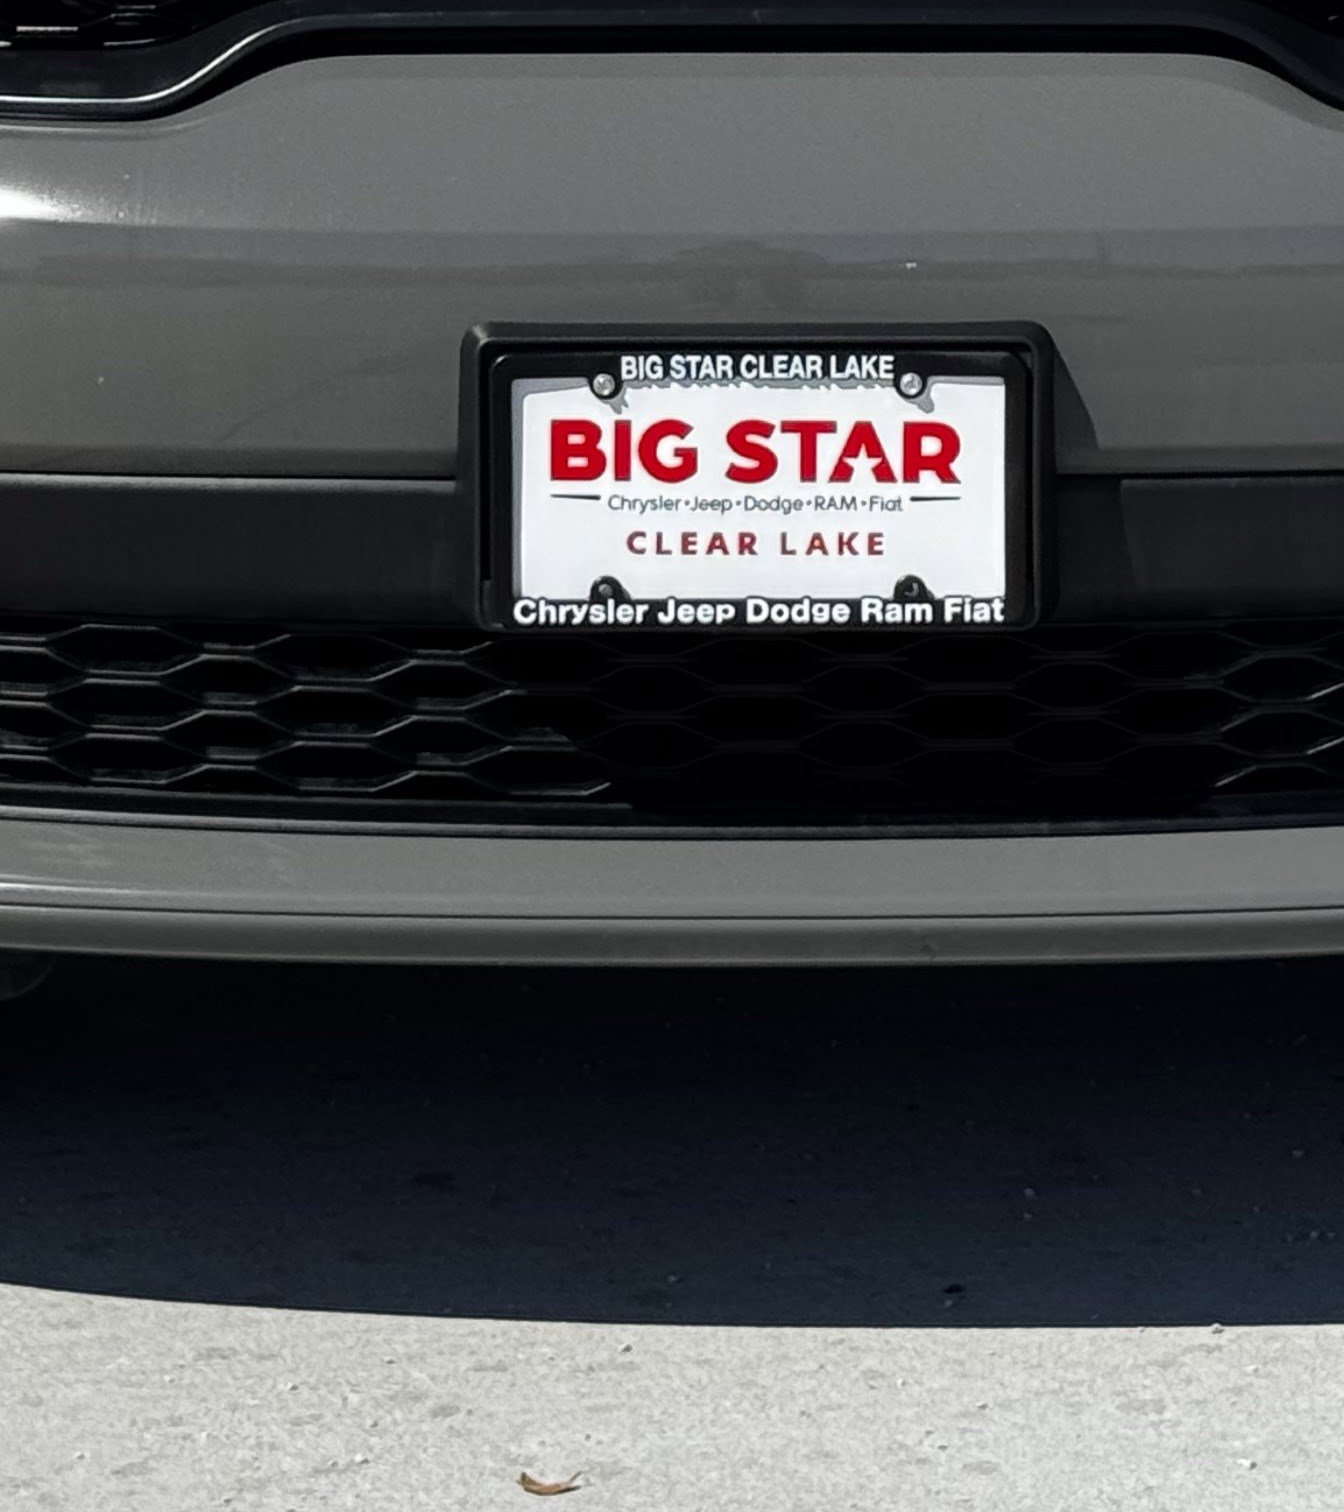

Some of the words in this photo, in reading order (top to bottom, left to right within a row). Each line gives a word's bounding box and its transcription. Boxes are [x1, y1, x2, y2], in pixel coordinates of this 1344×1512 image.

[620, 355, 663, 381] BIG
[669, 355, 734, 380] STAR
[739, 355, 823, 380] CLEAR
[829, 355, 895, 380] LAKE
[550, 419, 698, 483] BIG
[725, 419, 962, 484] STAR
[607, 494, 682, 514] Chrysler
[688, 495, 734, 514] Jeep
[744, 494, 804, 514] Dodge
[814, 495, 857, 511] RAM
[869, 495, 904, 512] Fiat
[626, 531, 758, 556] CLEAR
[780, 531, 885, 556] LAKE
[513, 598, 650, 625] Chrysler
[657, 598, 735, 625] Jeep
[745, 598, 850, 625] Dodge
[860, 597, 934, 624] Ram
[944, 596, 1005, 624] Fiat
